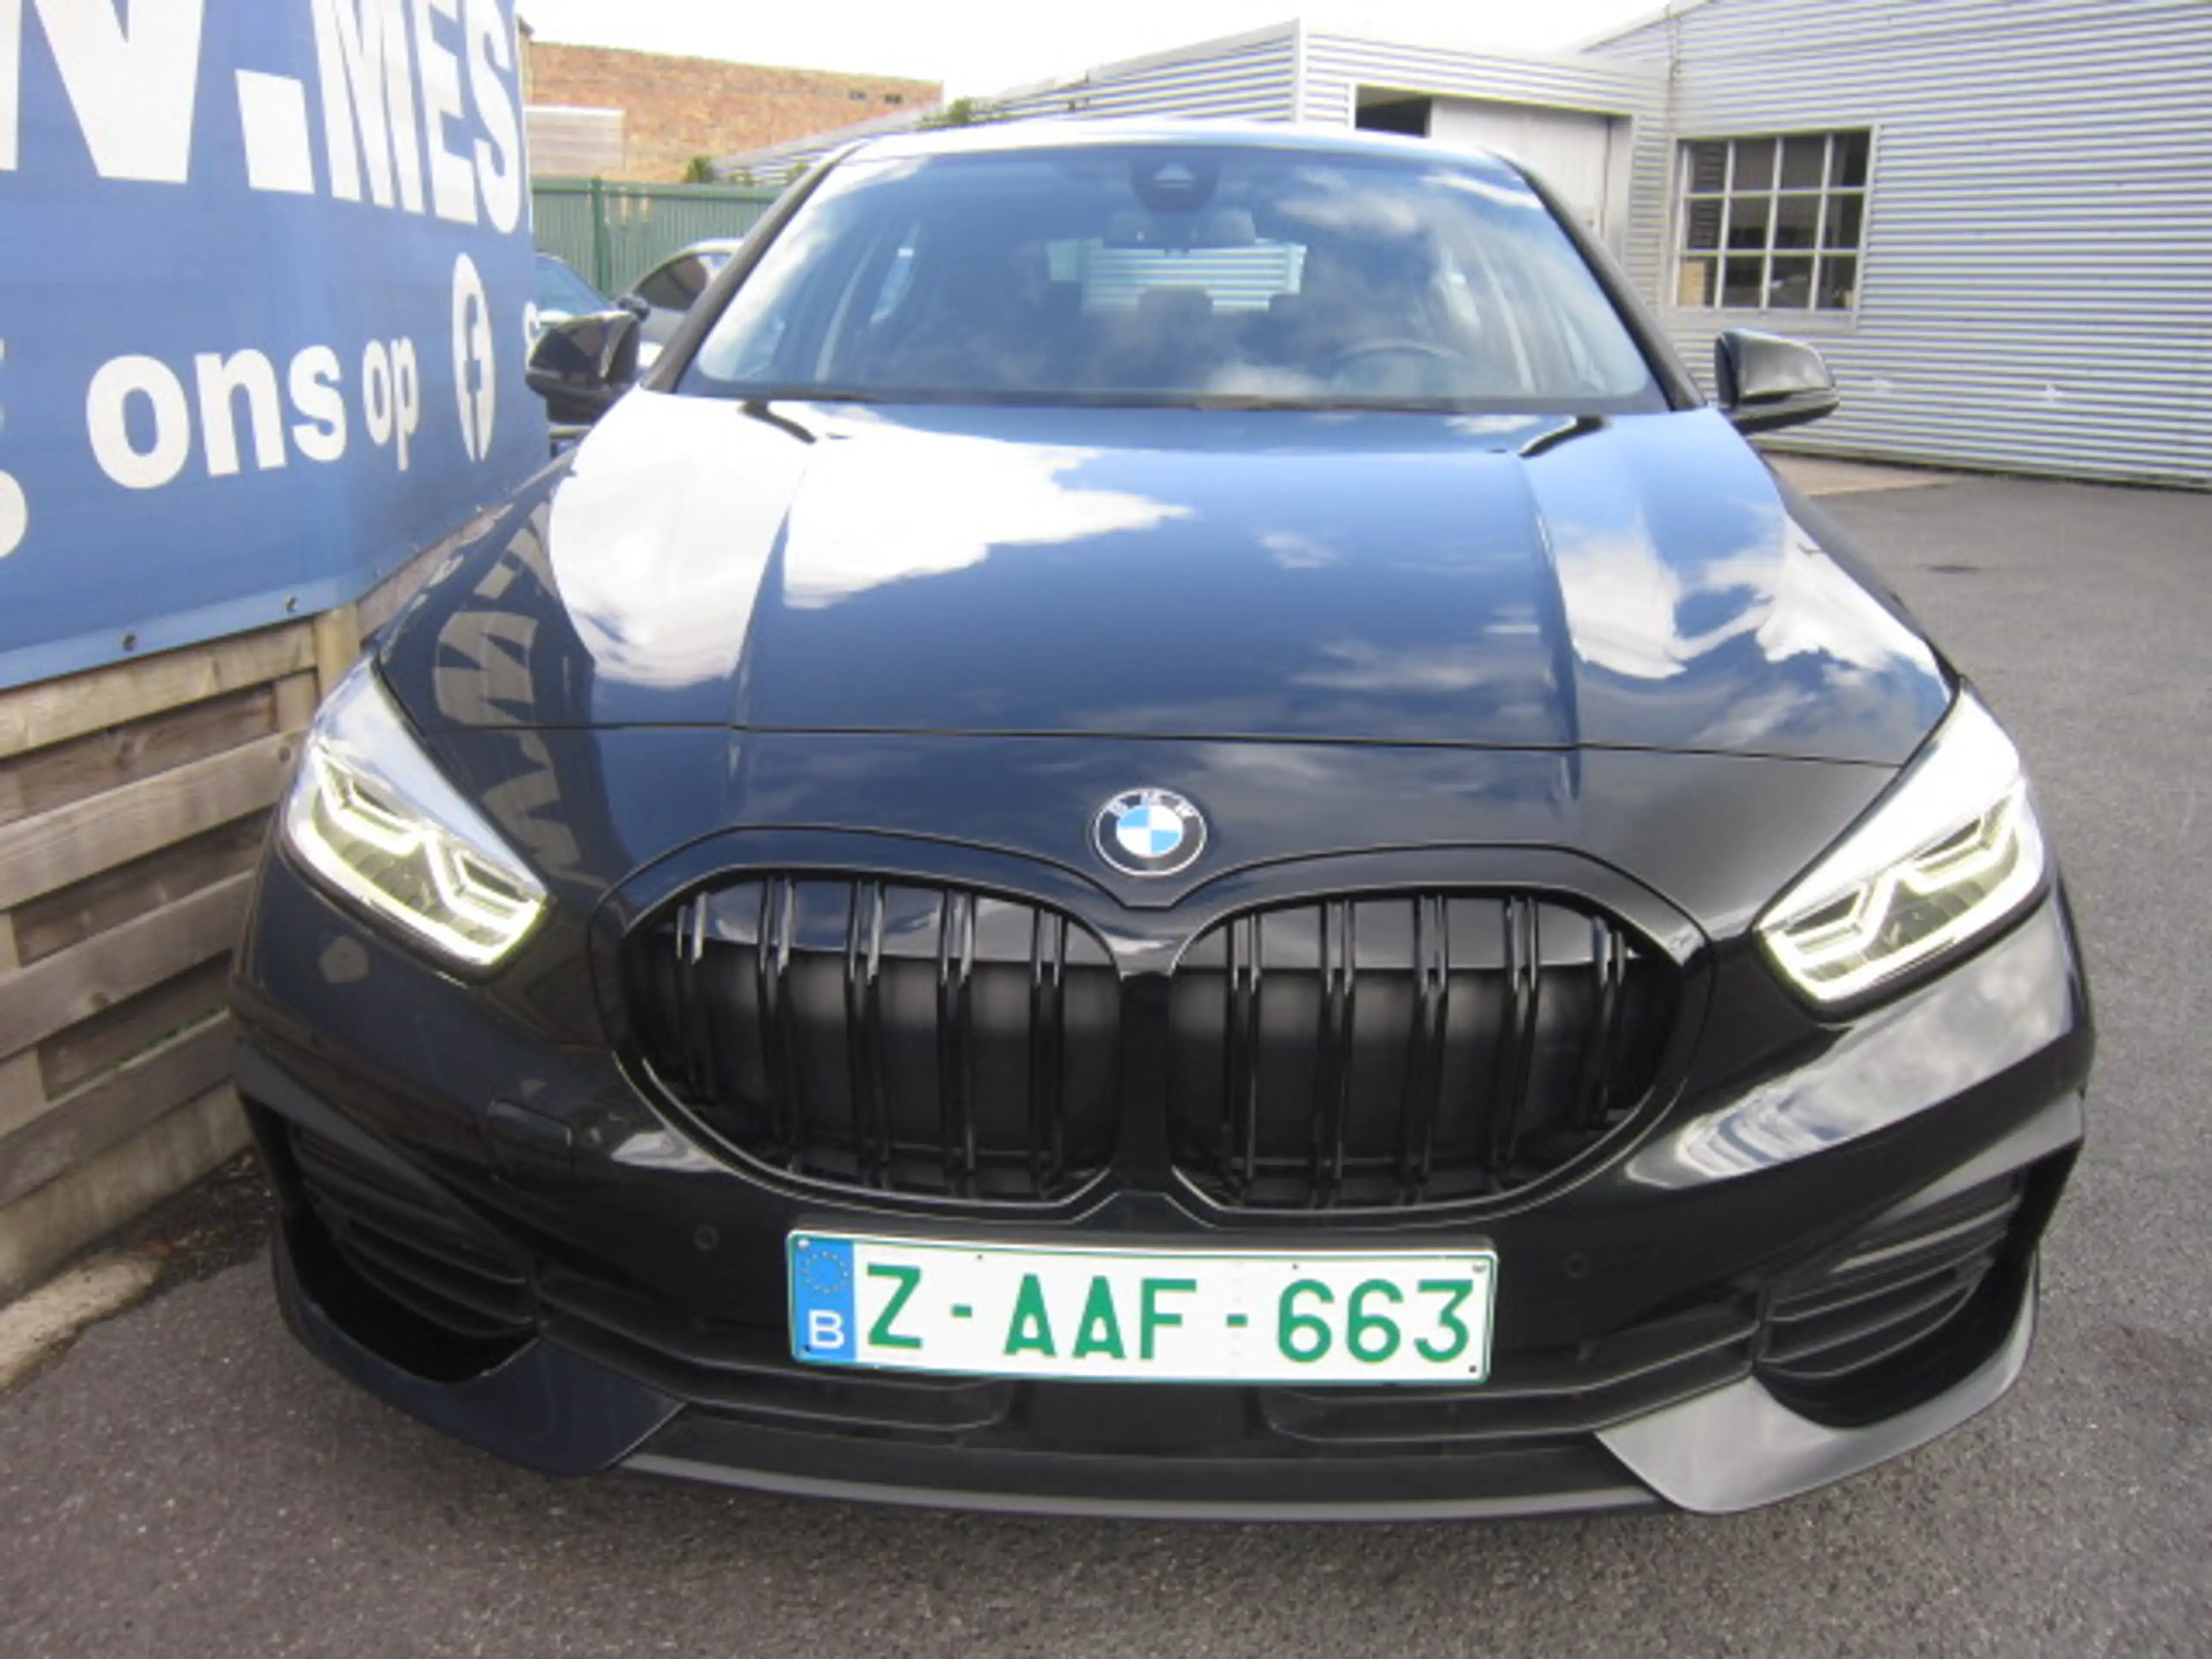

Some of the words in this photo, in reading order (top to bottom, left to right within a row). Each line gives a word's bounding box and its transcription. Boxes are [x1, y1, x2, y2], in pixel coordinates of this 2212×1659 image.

[86, 345, 347, 489] ons
[362, 336, 419, 471] op
[809, 1309, 844, 1349] B
